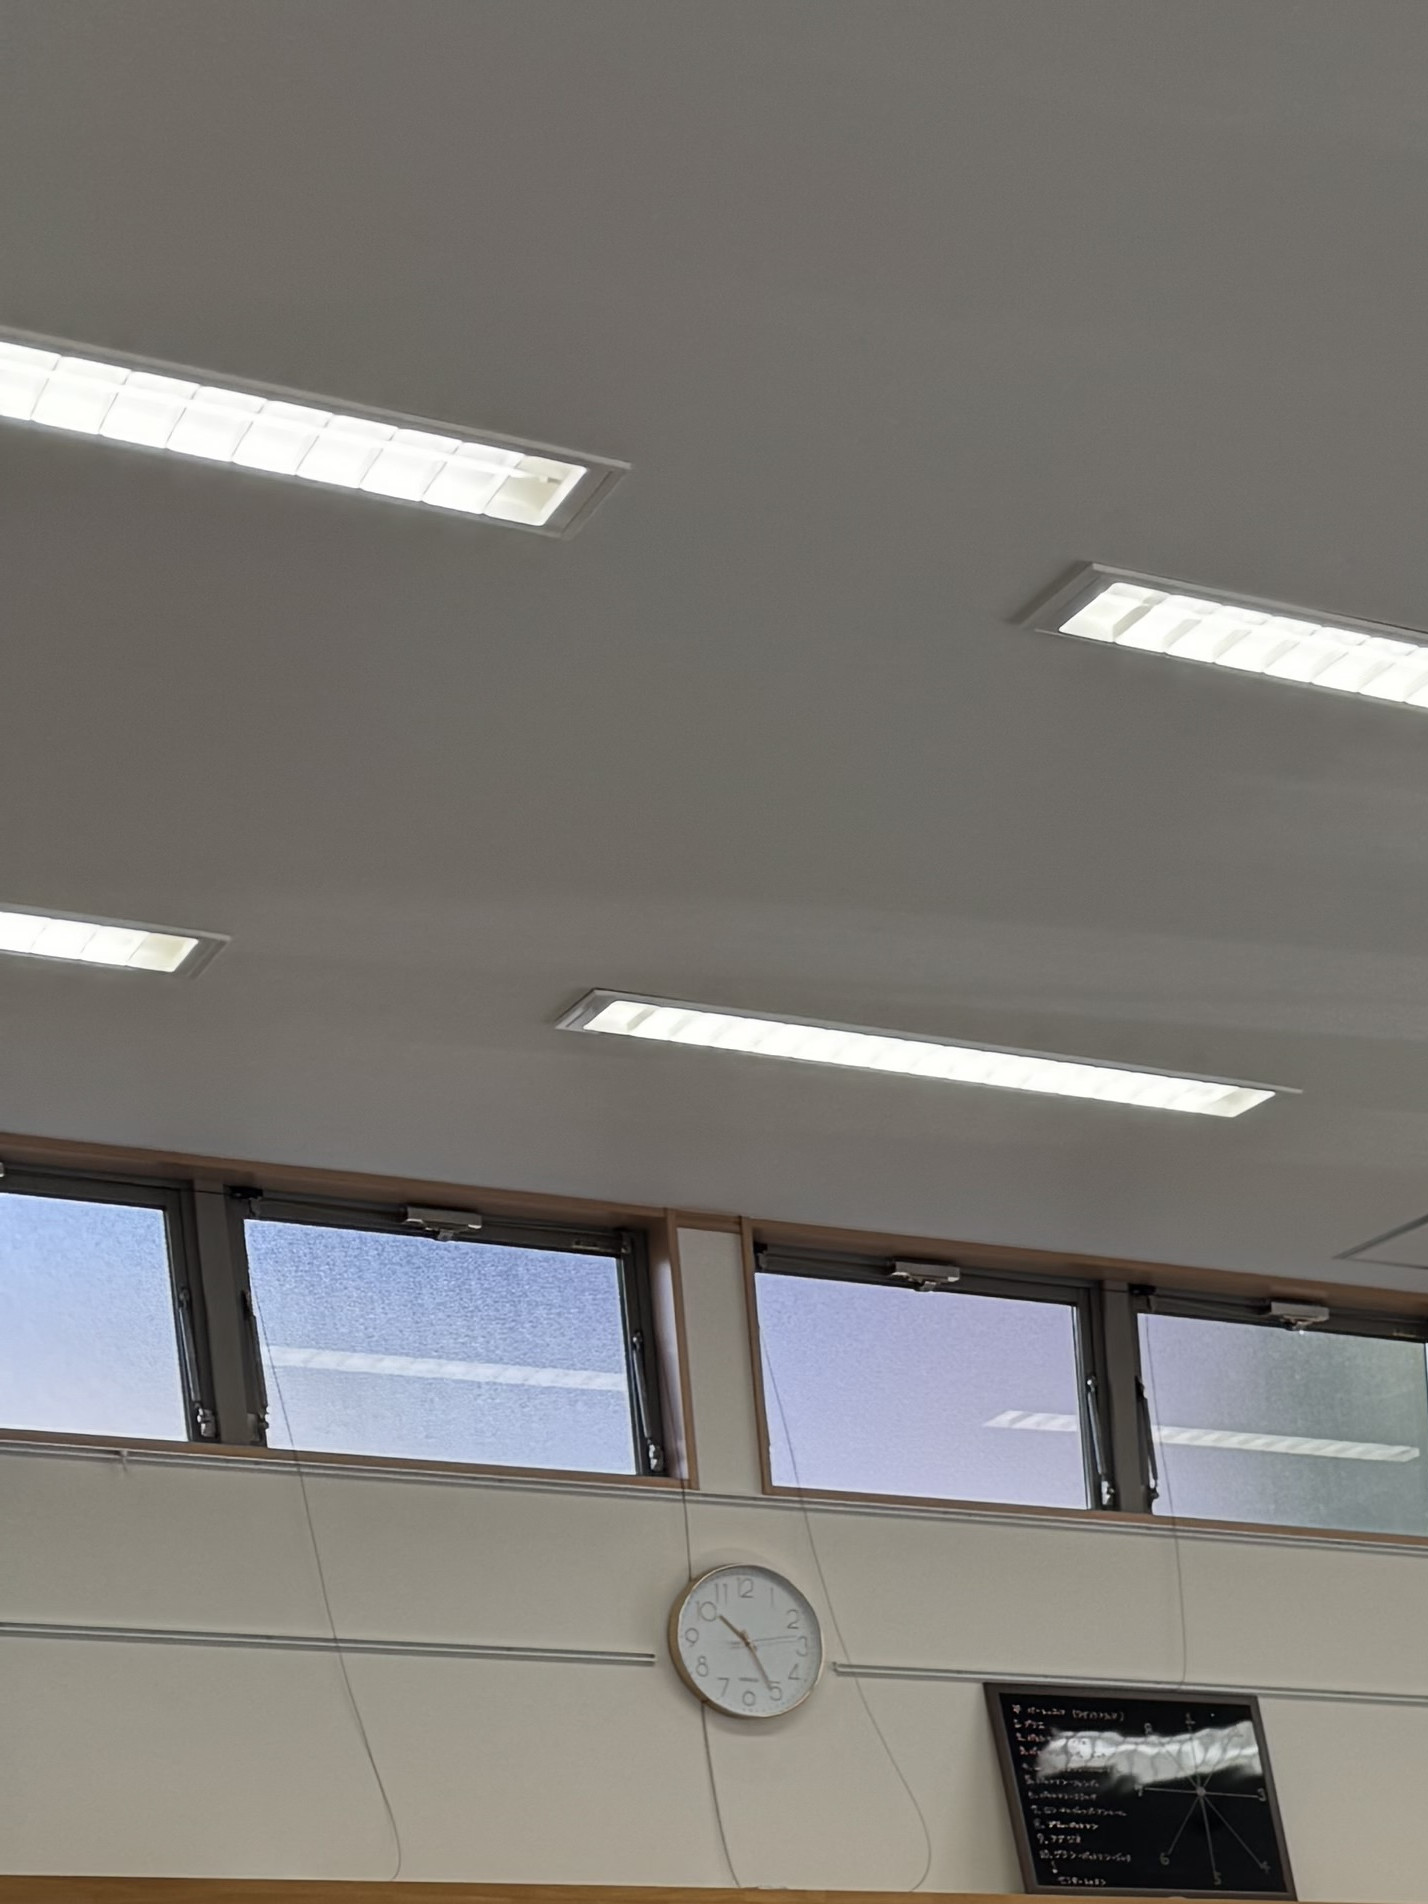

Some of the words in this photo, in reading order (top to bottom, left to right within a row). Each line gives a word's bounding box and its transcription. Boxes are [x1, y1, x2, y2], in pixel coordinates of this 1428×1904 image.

[715, 1583, 728, 1605] 11
[737, 1578, 754, 1598] 12
[697, 1601, 717, 1622] 10
[787, 1609, 800, 1630] 2
[685, 1628, 699, 1647] 9
[795, 1636, 808, 1657] 3
[696, 1655, 709, 1677] 8
[788, 1663, 801, 1681] 4
[717, 1677, 730, 1698] 7
[768, 1680, 783, 1702] 5
[1257, 1788, 1267, 1802] 3
[1160, 1852, 1170, 1865] 6
